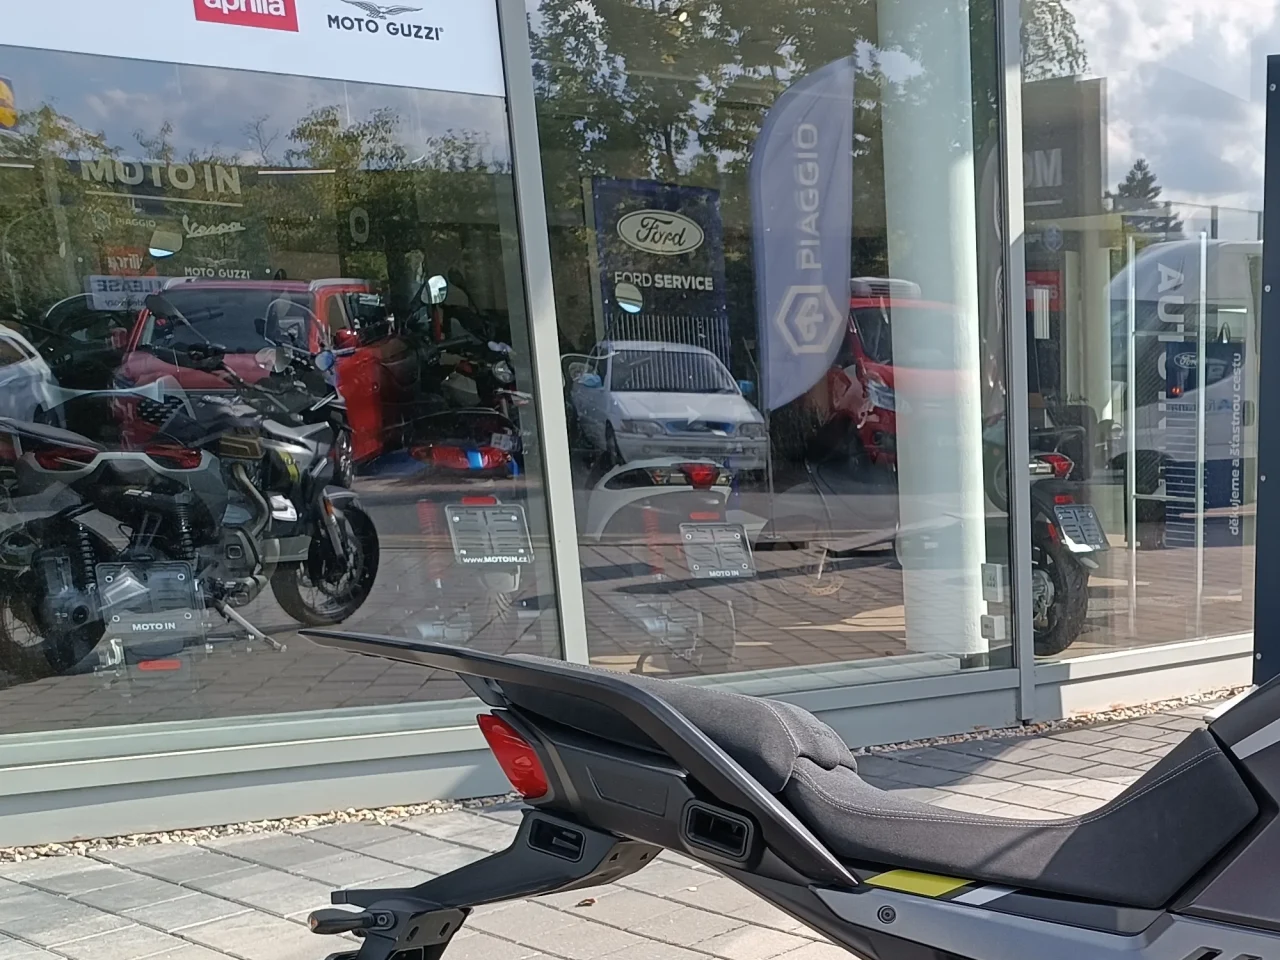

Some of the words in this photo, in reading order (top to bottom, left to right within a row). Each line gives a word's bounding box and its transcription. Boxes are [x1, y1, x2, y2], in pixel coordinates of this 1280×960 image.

[327, 14, 379, 33] MOTO
[386, 22, 440, 41] GUZZI
[81, 160, 196, 190] MOTO
[204, 163, 242, 195] IN
[796, 122, 821, 270] PIAGGIO
[182, 214, 247, 239] Vespa
[636, 216, 687, 247] Ford
[184, 267, 215, 277] MOTO
[218, 268, 251, 280] GUZZI
[614, 271, 652, 287] FORD
[654, 274, 714, 291] SERVICE
[1231, 352, 1241, 391] cestu
[1231, 459, 1240, 467] a
[1228, 471, 1240, 536] děkujeme
[463, 555, 528, 563] www.MOTOIN.cz
[132, 623, 163, 631] MOTO
[165, 622, 176, 630] IN
